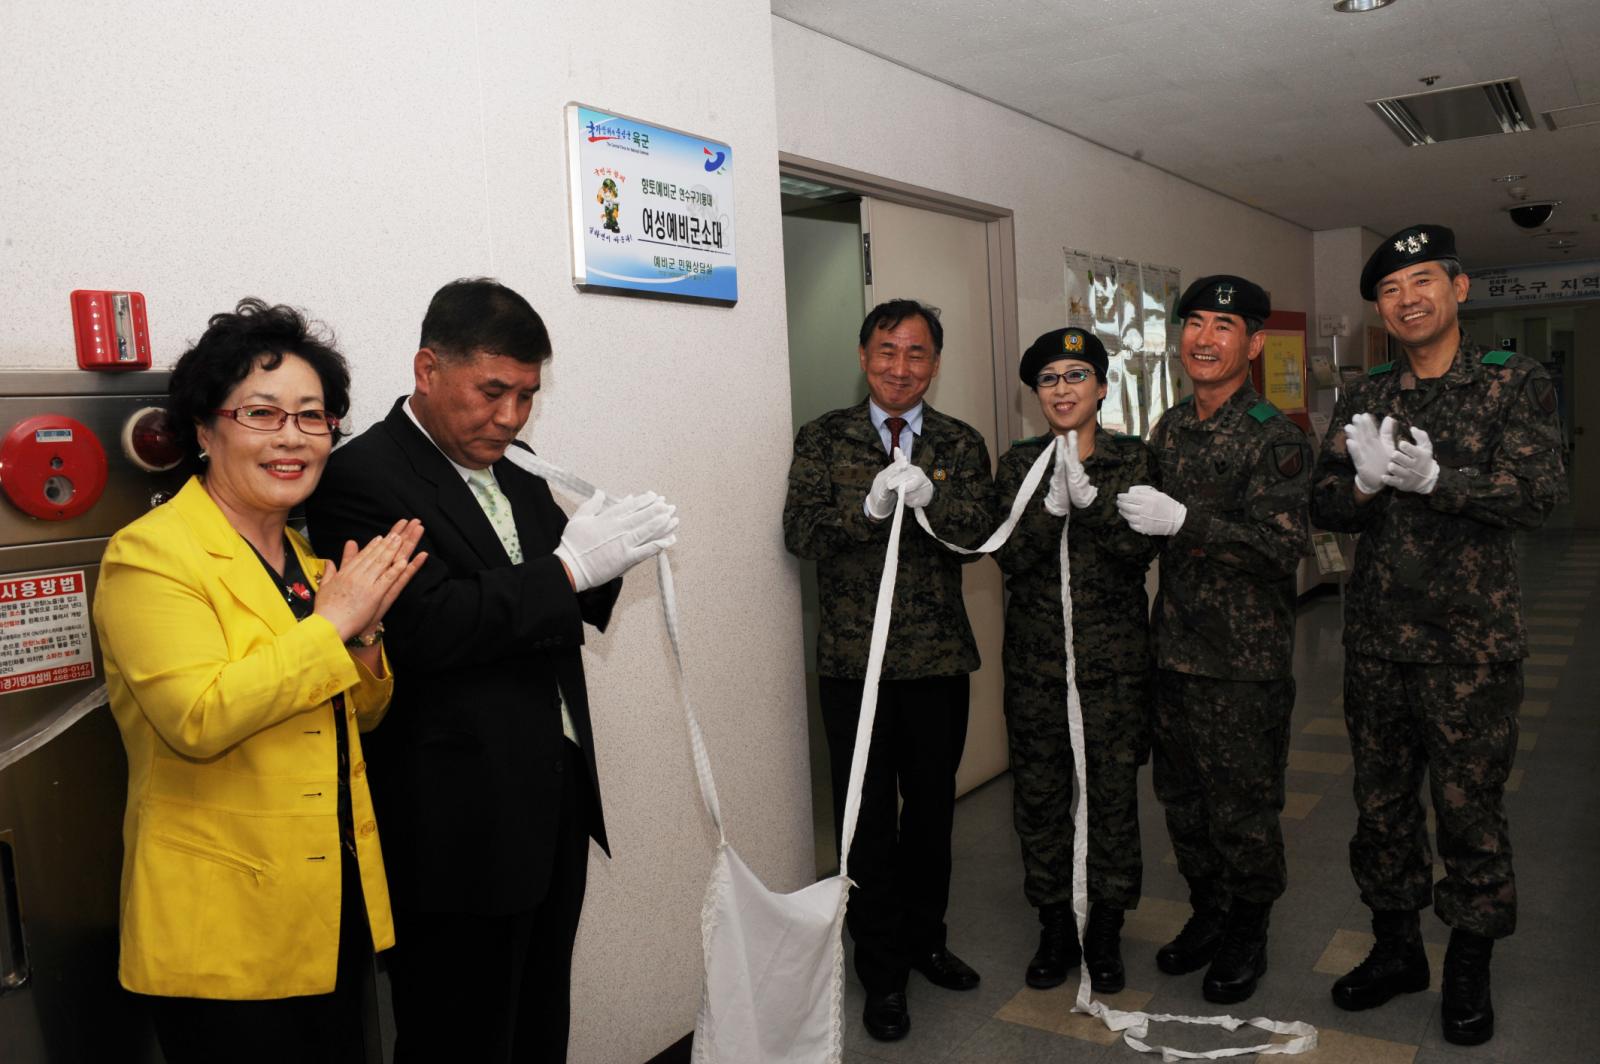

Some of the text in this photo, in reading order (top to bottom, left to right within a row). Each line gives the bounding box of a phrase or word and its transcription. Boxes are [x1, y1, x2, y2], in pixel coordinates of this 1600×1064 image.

[632, 131, 649, 149] 육군
[641, 178, 713, 208] 향토예비군 연수구기동대
[642, 207, 723, 249] 여성예비군소대
[653, 255, 713, 275] 예비군 민원상담실
[1489, 281, 1548, 297] 연수구
[1, 577, 75, 599] 사용방법
